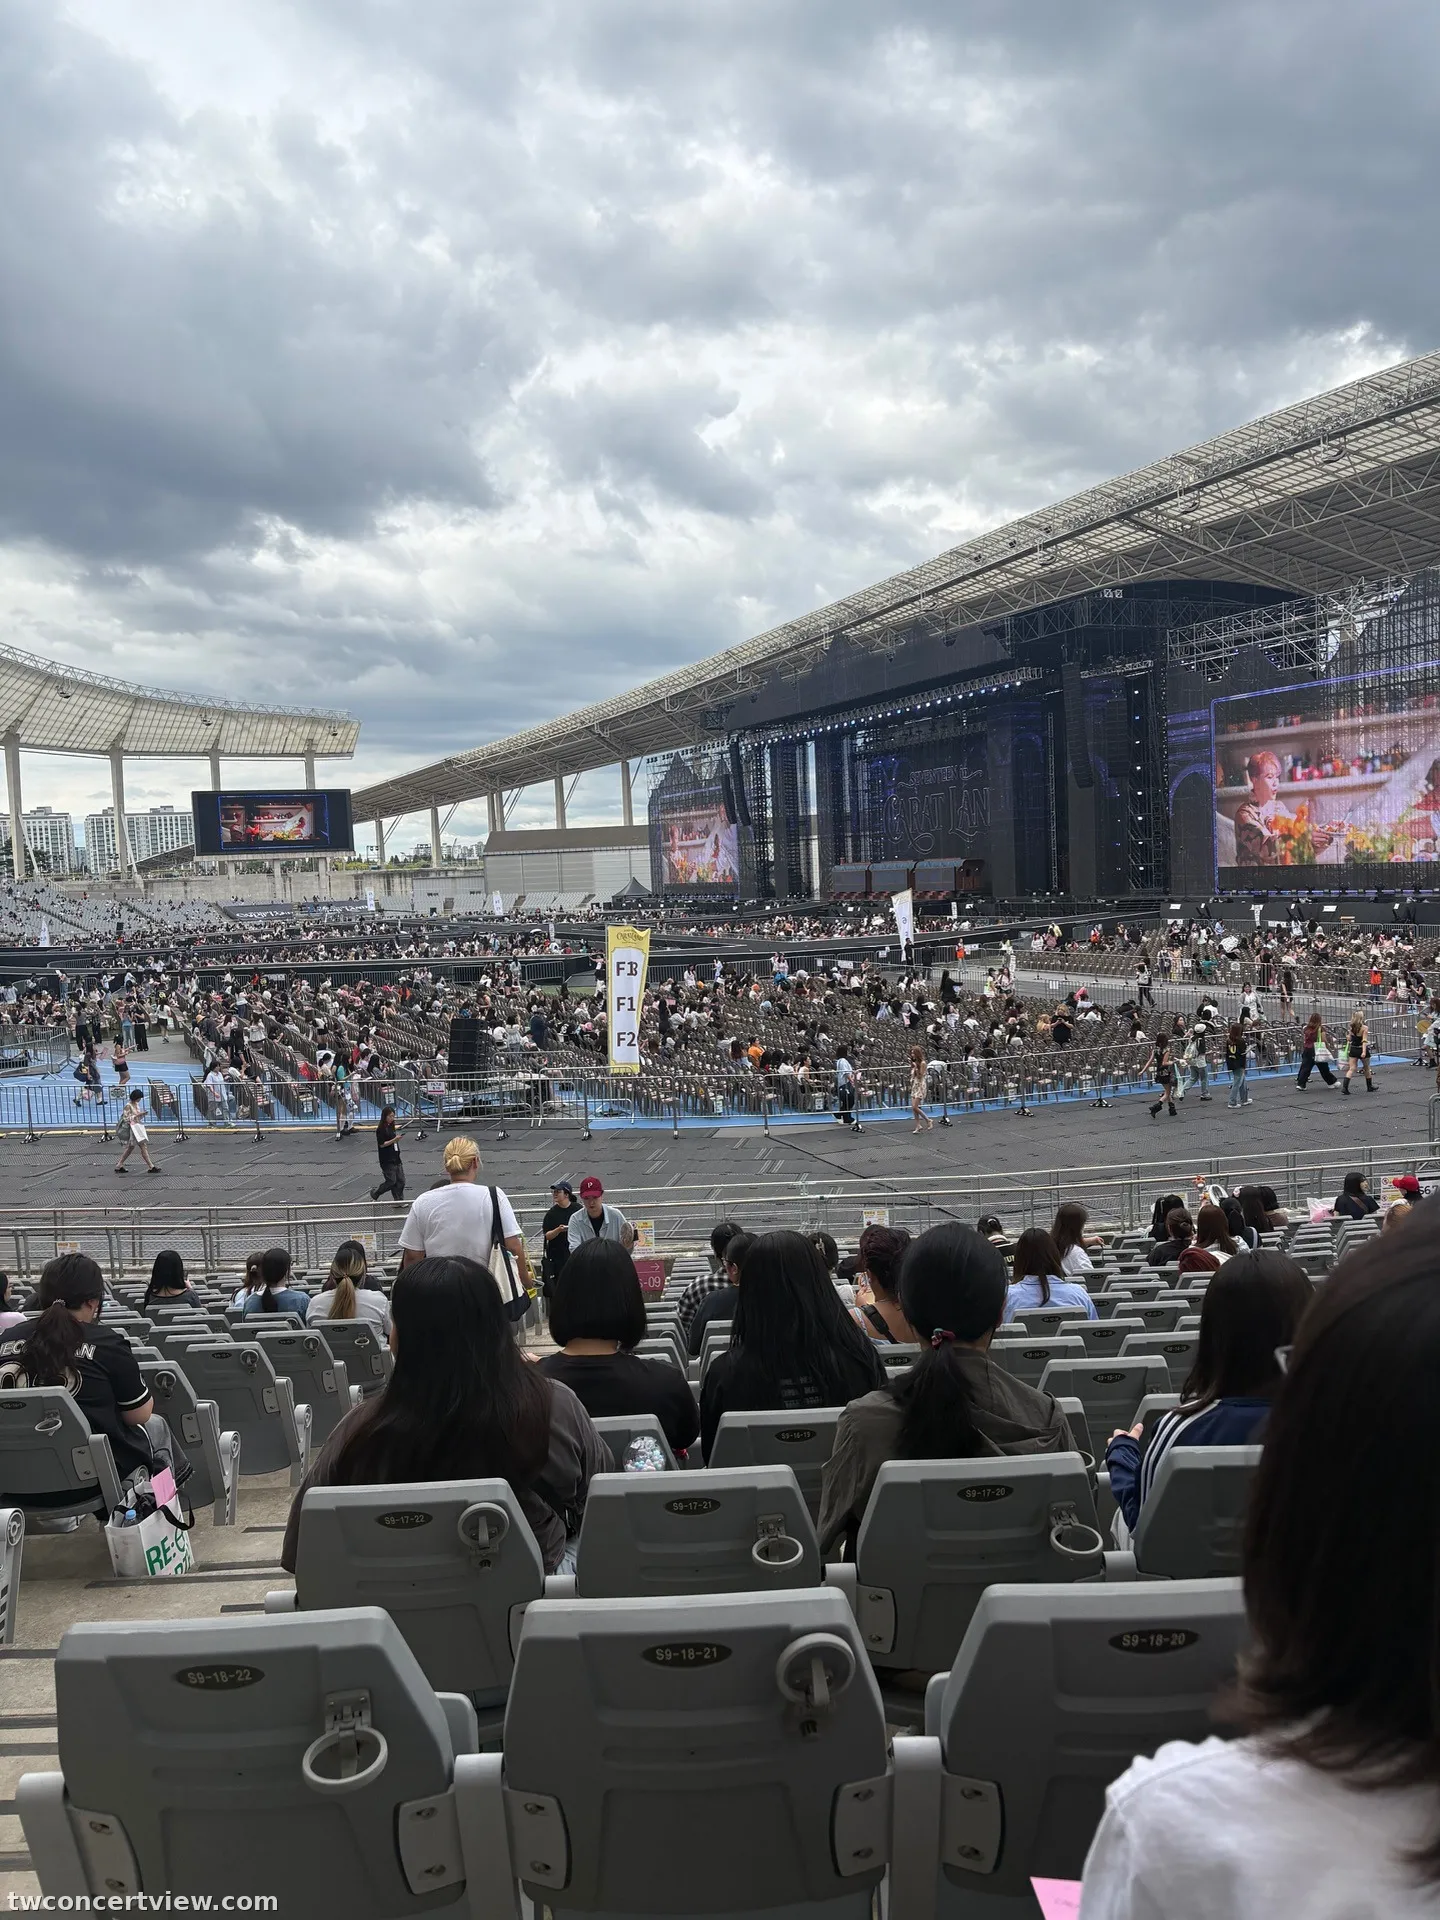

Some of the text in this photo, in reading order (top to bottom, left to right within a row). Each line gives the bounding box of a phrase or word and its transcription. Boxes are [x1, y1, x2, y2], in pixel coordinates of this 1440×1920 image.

[948, 785, 991, 842] LAN
[616, 996, 636, 1012] F1
[616, 1031, 637, 1047] F2
[965, 1487, 1006, 1498] S9-17-20
[672, 1501, 712, 1511] S9-17-21
[384, 1514, 425, 1525] S9-17-22
[1122, 1633, 1186, 1647] S9-18-20
[656, 1647, 717, 1660] S9-18-21
[187, 1669, 252, 1684] S9-18-22
